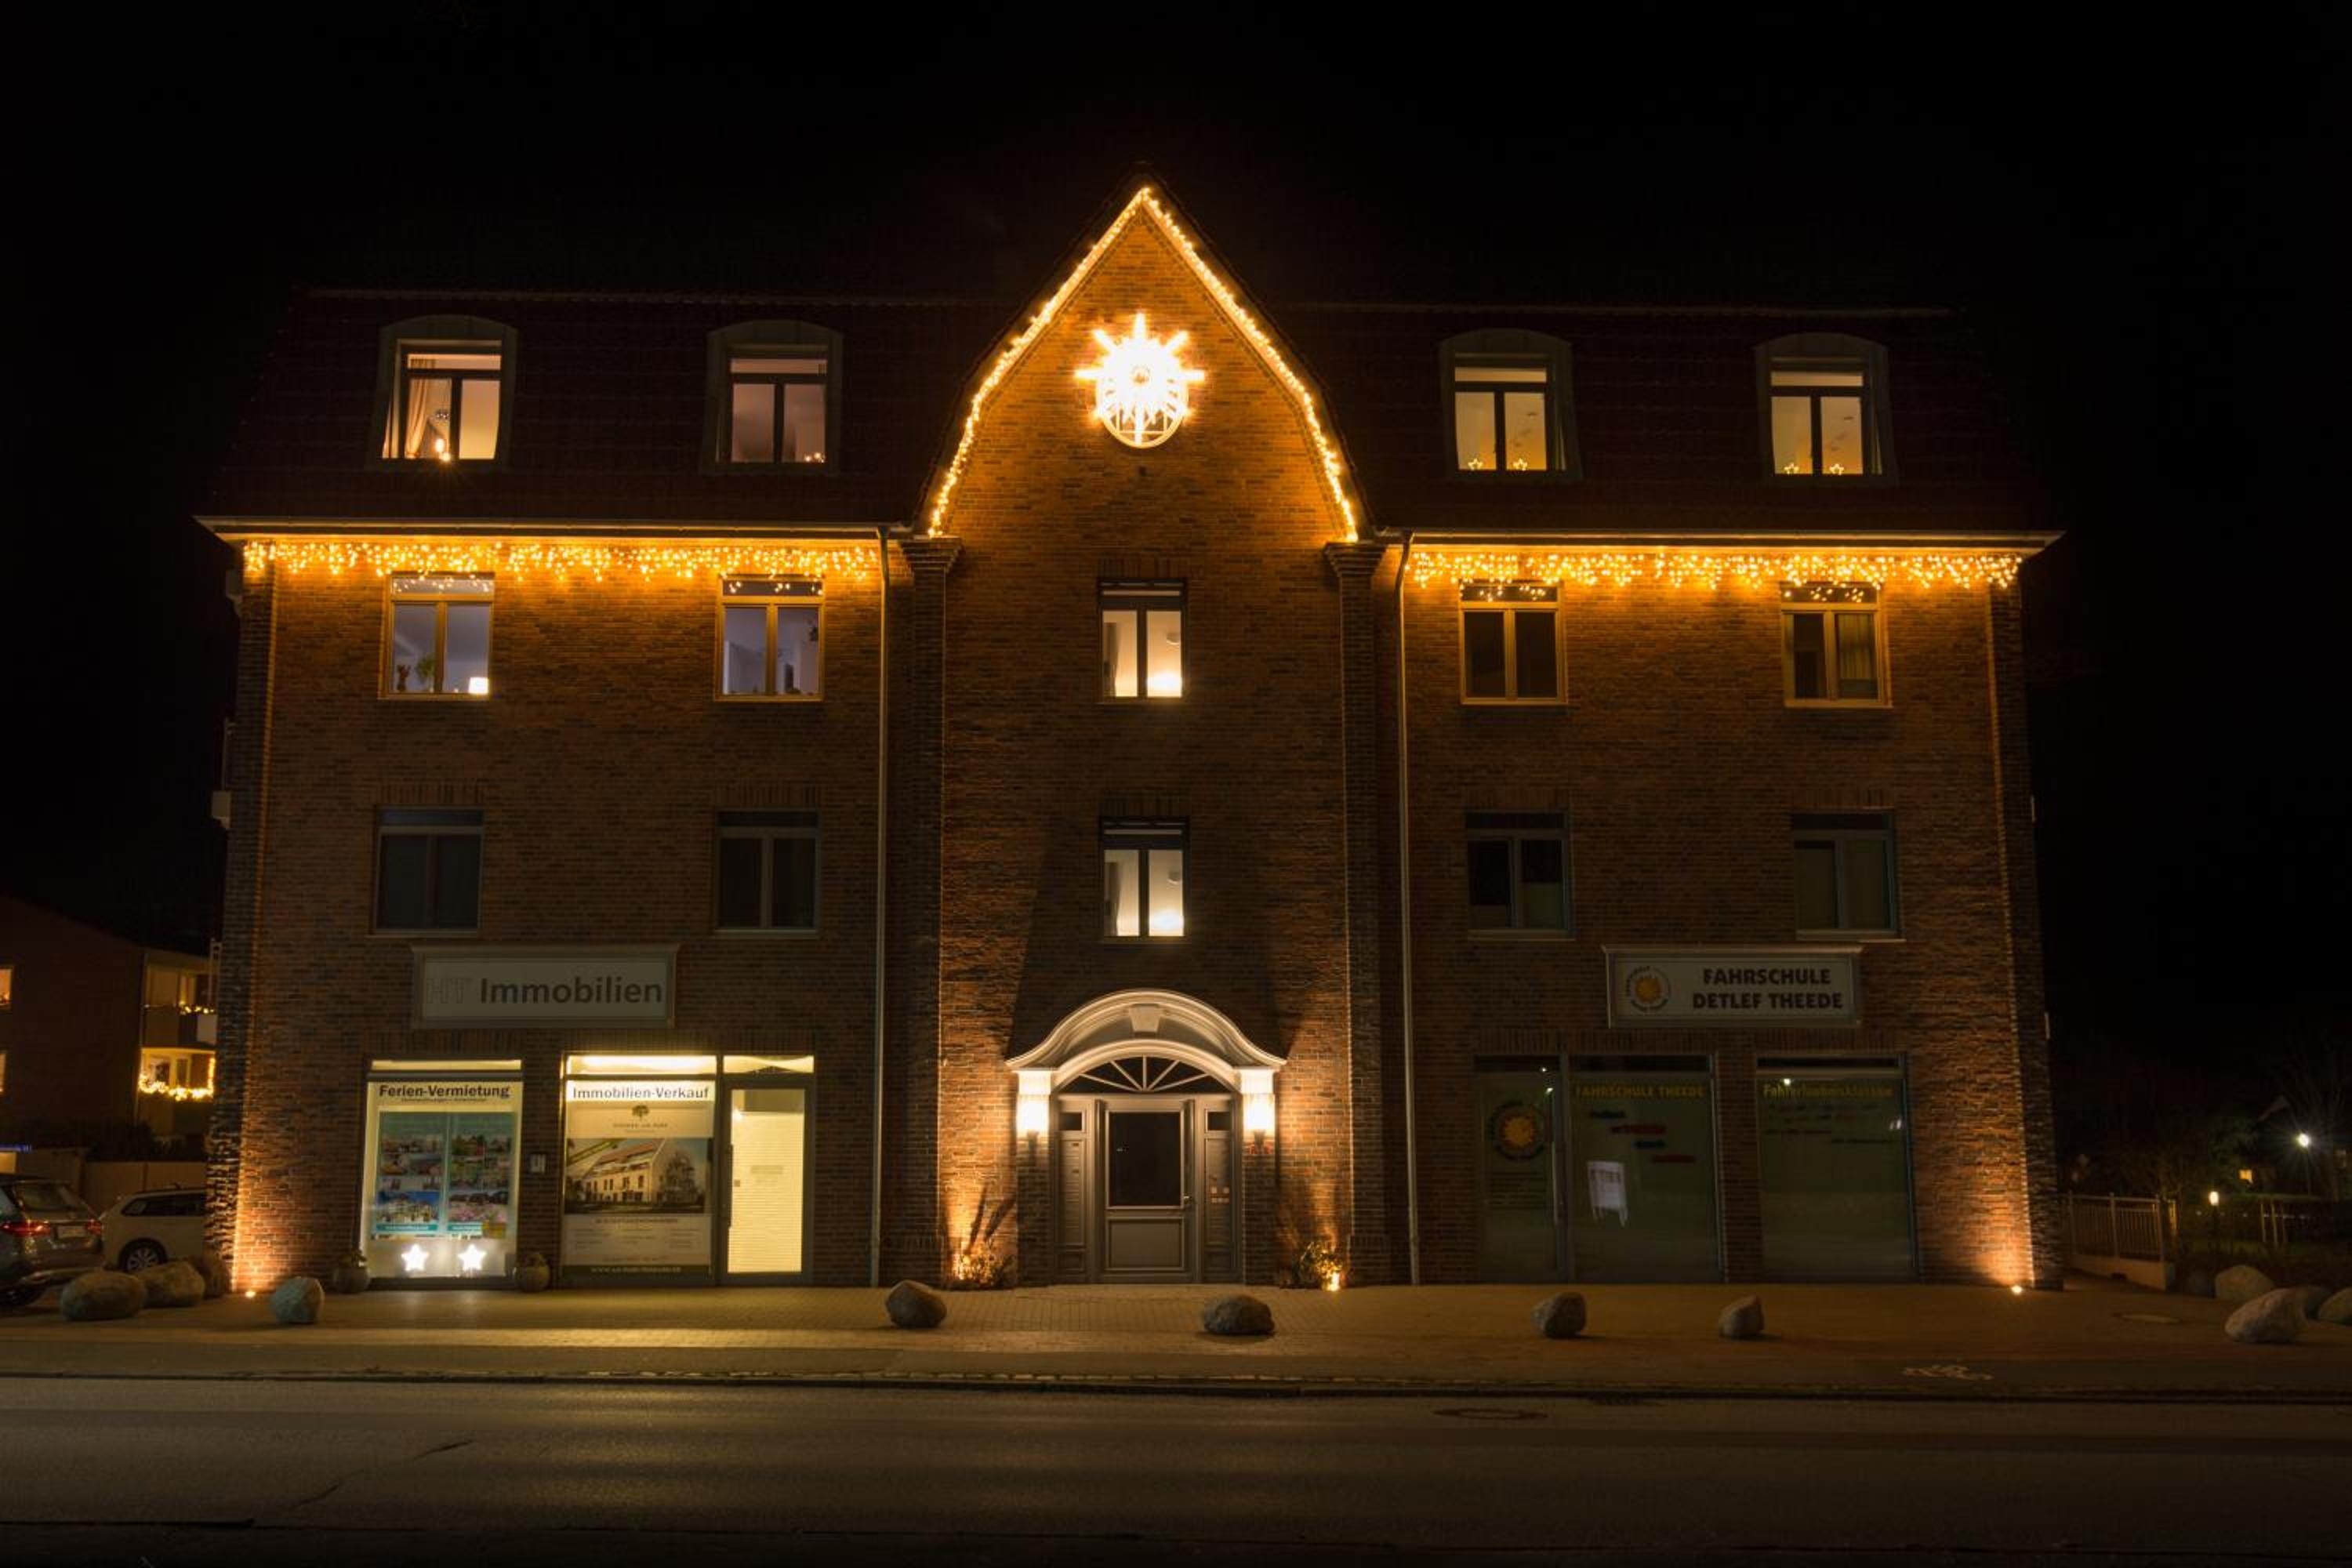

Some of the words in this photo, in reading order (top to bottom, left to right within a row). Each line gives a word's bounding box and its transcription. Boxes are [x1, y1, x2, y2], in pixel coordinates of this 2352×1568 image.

[1703, 968, 1831, 985] FAHRSCHULE
[481, 976, 662, 1004] Immobilien
[1693, 993, 1761, 1009] DETLEF
[1768, 993, 1843, 1009] THEEDE
[379, 1084, 510, 1099] Ferien-Vermietung
[573, 1087, 709, 1099] Immobilien-Verkauf
[1576, 1085, 1653, 1098] FAHRSCHULE
[1658, 1085, 1705, 1098] THEEDE
